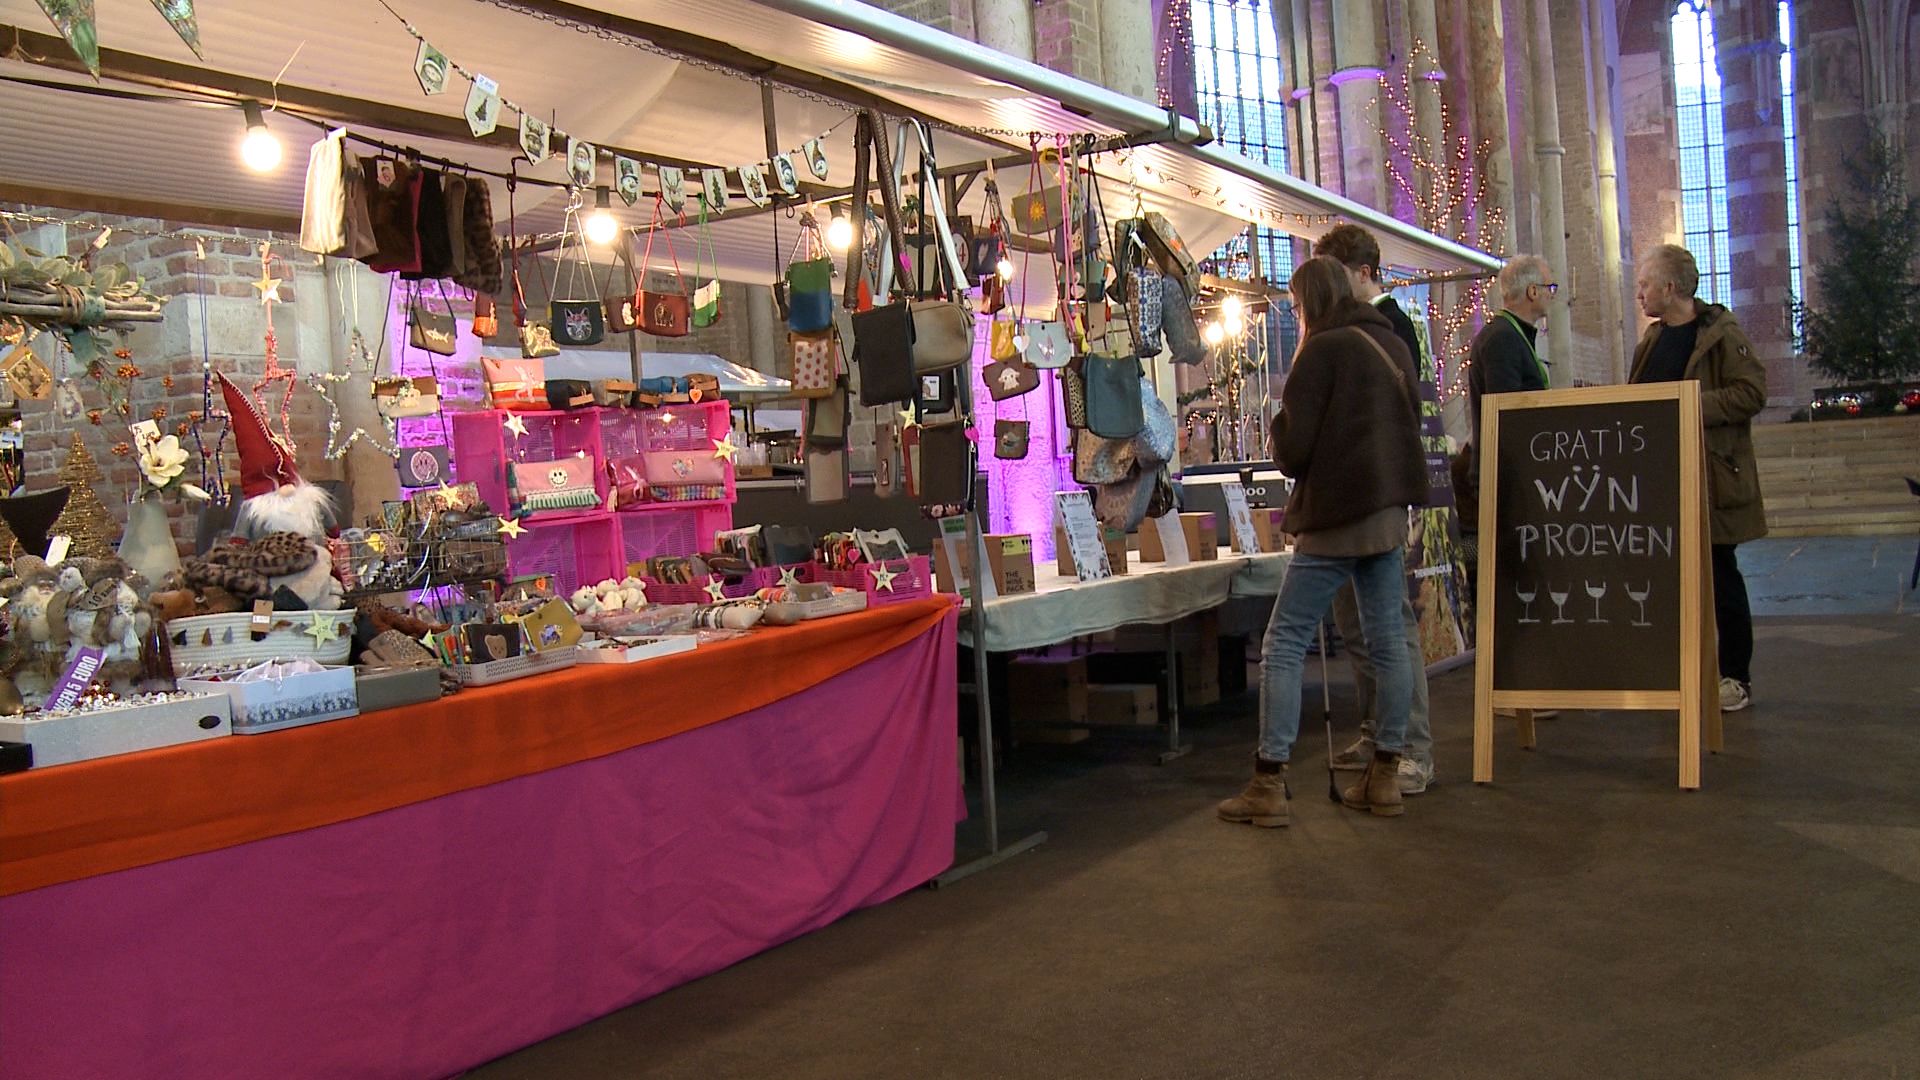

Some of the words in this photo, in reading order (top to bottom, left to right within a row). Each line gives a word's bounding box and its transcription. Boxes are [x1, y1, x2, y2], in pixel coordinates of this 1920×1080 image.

[1515, 523, 1673, 562] PROEVEN
[1006, 585, 1025, 593] PACK
[71, 655, 99, 682] EURO
[66, 681, 82, 691] 5
